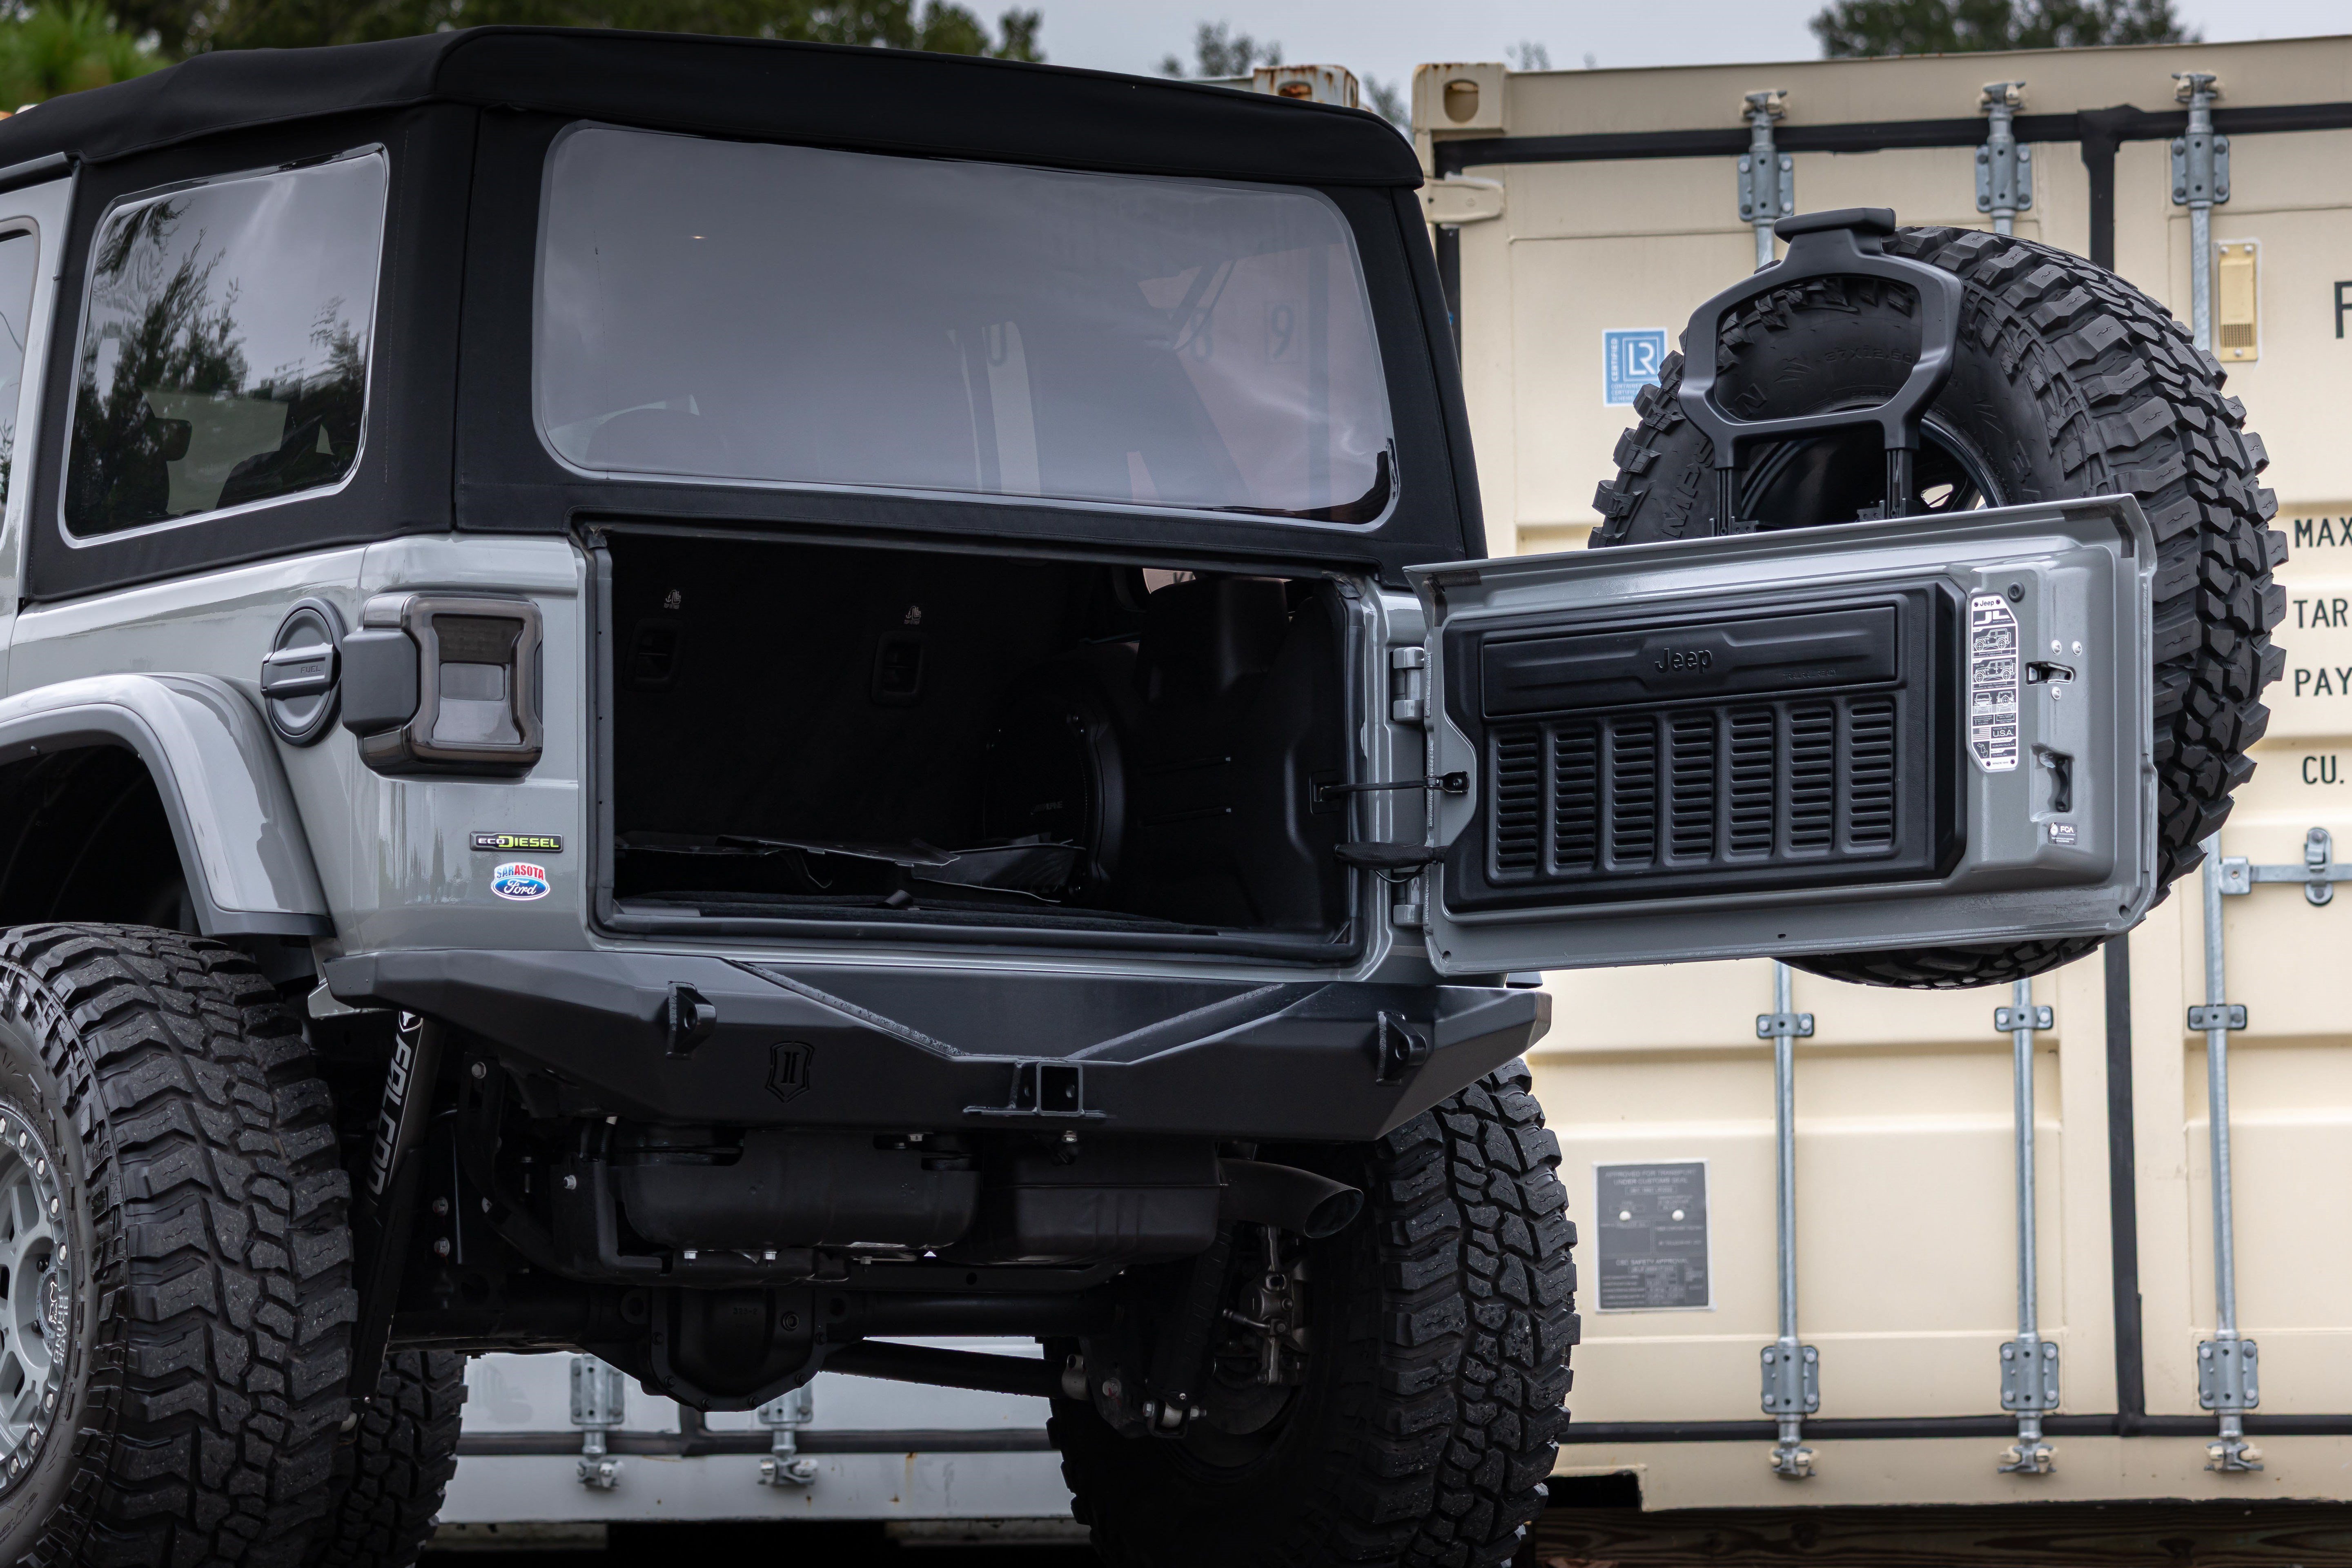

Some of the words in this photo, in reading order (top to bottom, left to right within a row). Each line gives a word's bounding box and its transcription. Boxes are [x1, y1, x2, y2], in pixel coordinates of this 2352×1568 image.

[1973, 610, 2010, 625] JL
[1655, 648, 1713, 674] Jeep
[2302, 755, 2345, 785] CU.
[478, 835, 559, 848] ECODIESEL
[496, 865, 544, 880] SARASOTA
[503, 879, 538, 895] Ford
[368, 1033, 411, 1195] FALCON
